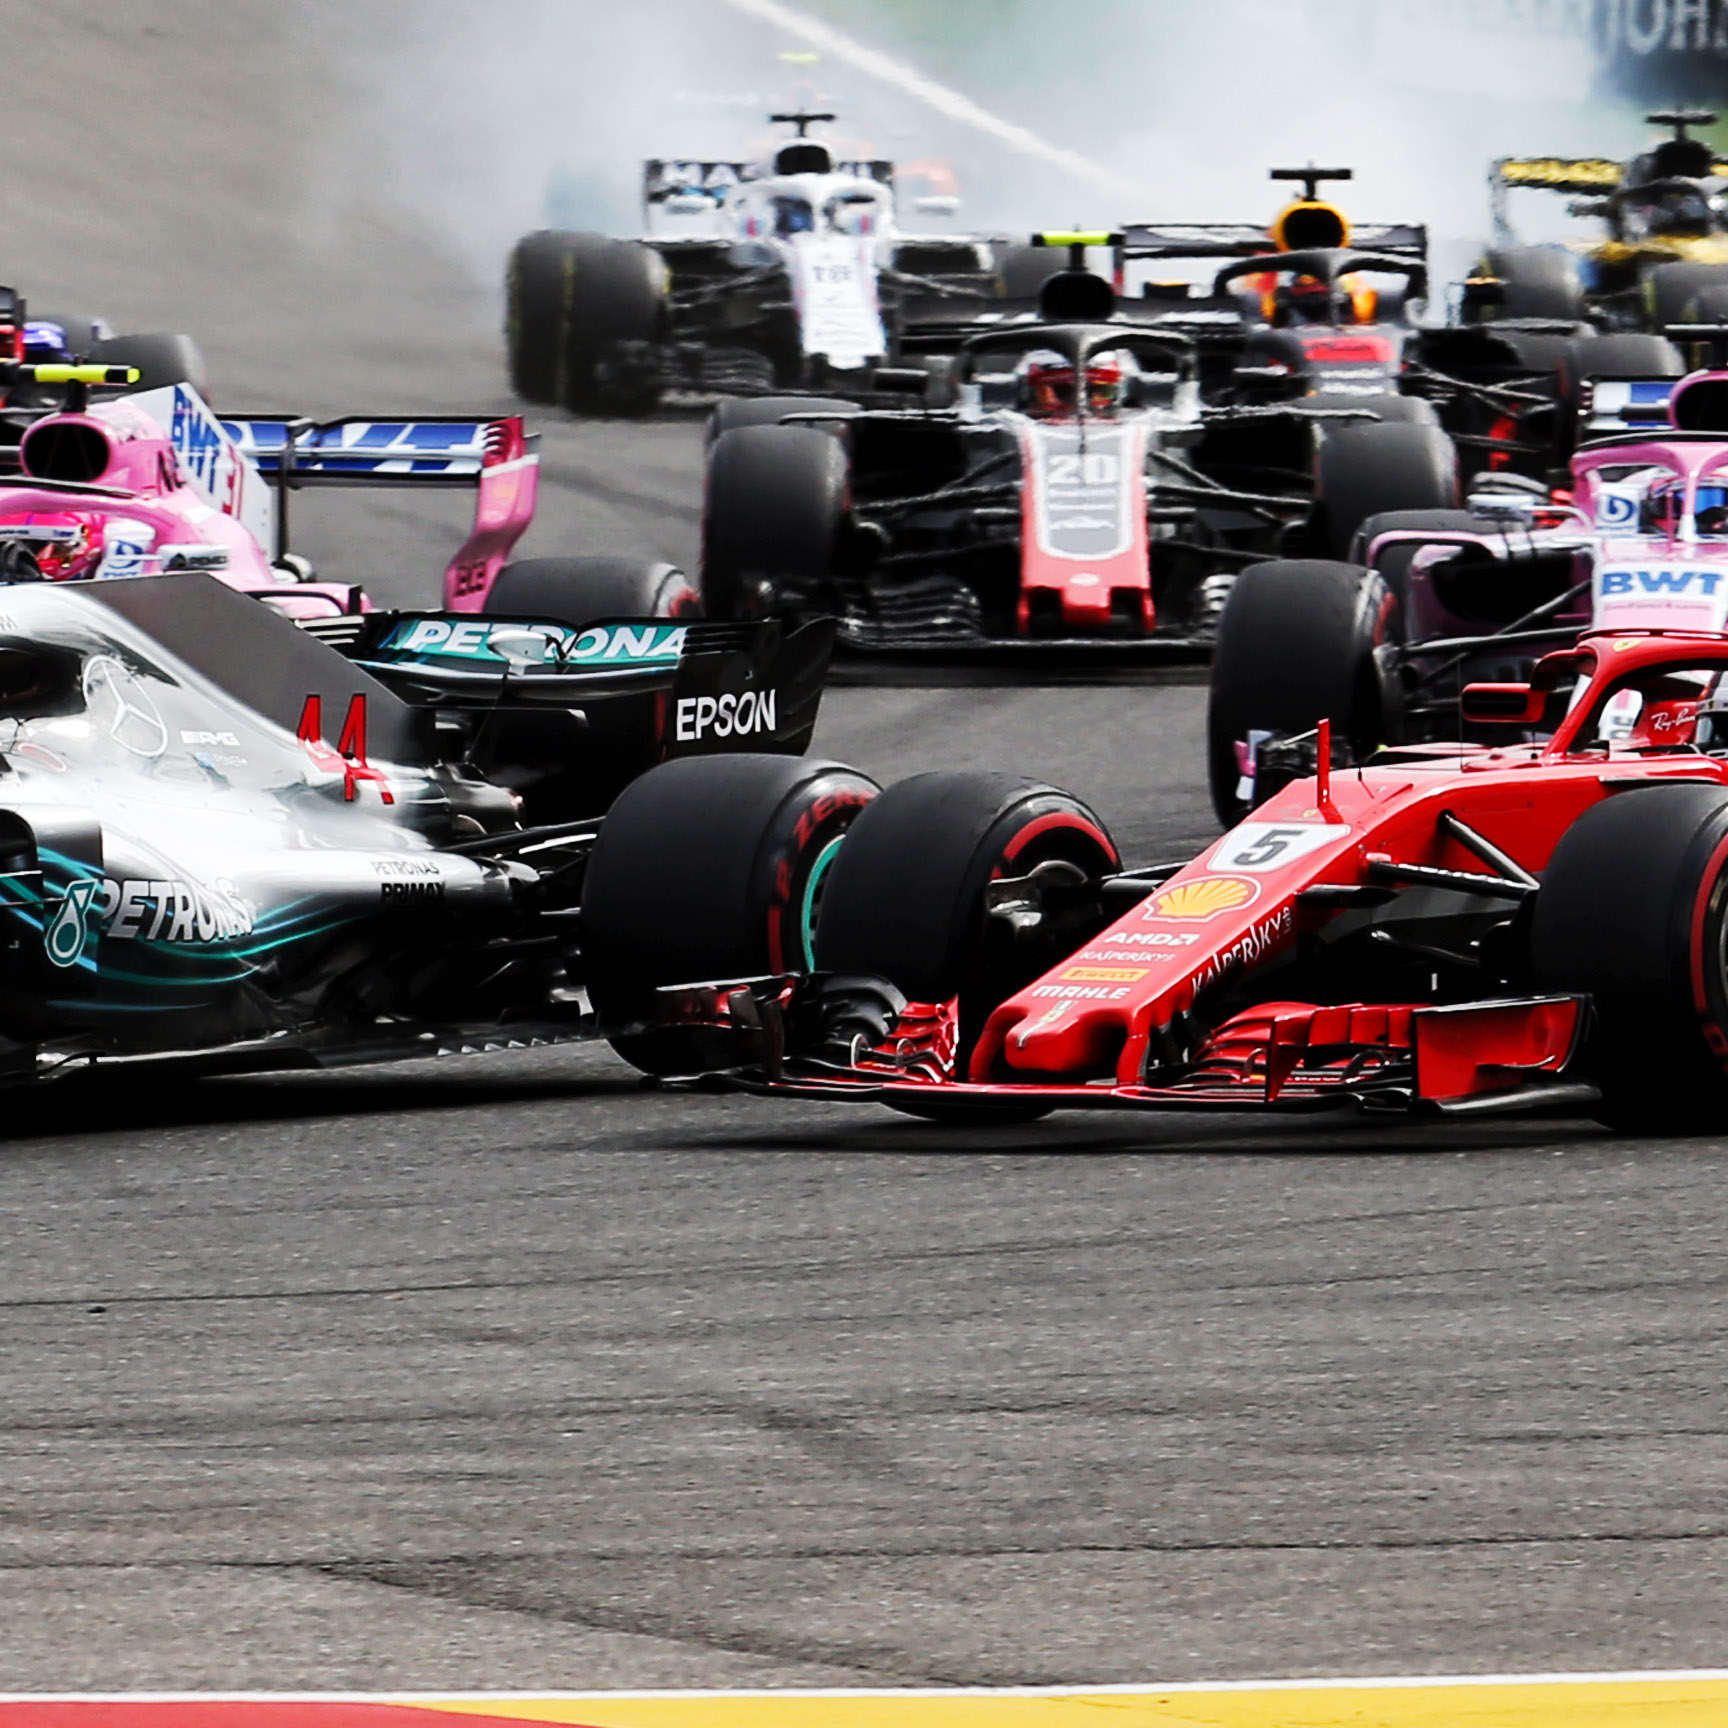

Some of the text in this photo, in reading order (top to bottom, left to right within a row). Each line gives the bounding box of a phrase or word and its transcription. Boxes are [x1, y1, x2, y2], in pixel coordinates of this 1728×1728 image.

[1047, 454, 1118, 484] 20
[1601, 571, 1724, 596] BWT
[403, 620, 688, 659] PETRONA
[675, 689, 777, 742] EPSON
[296, 693, 395, 806] 44
[1233, 828, 1304, 866] 5
[101, 877, 257, 943] PETRONAS
[1104, 933, 1192, 946] AMD
[1031, 984, 1132, 1000] MAHLE
